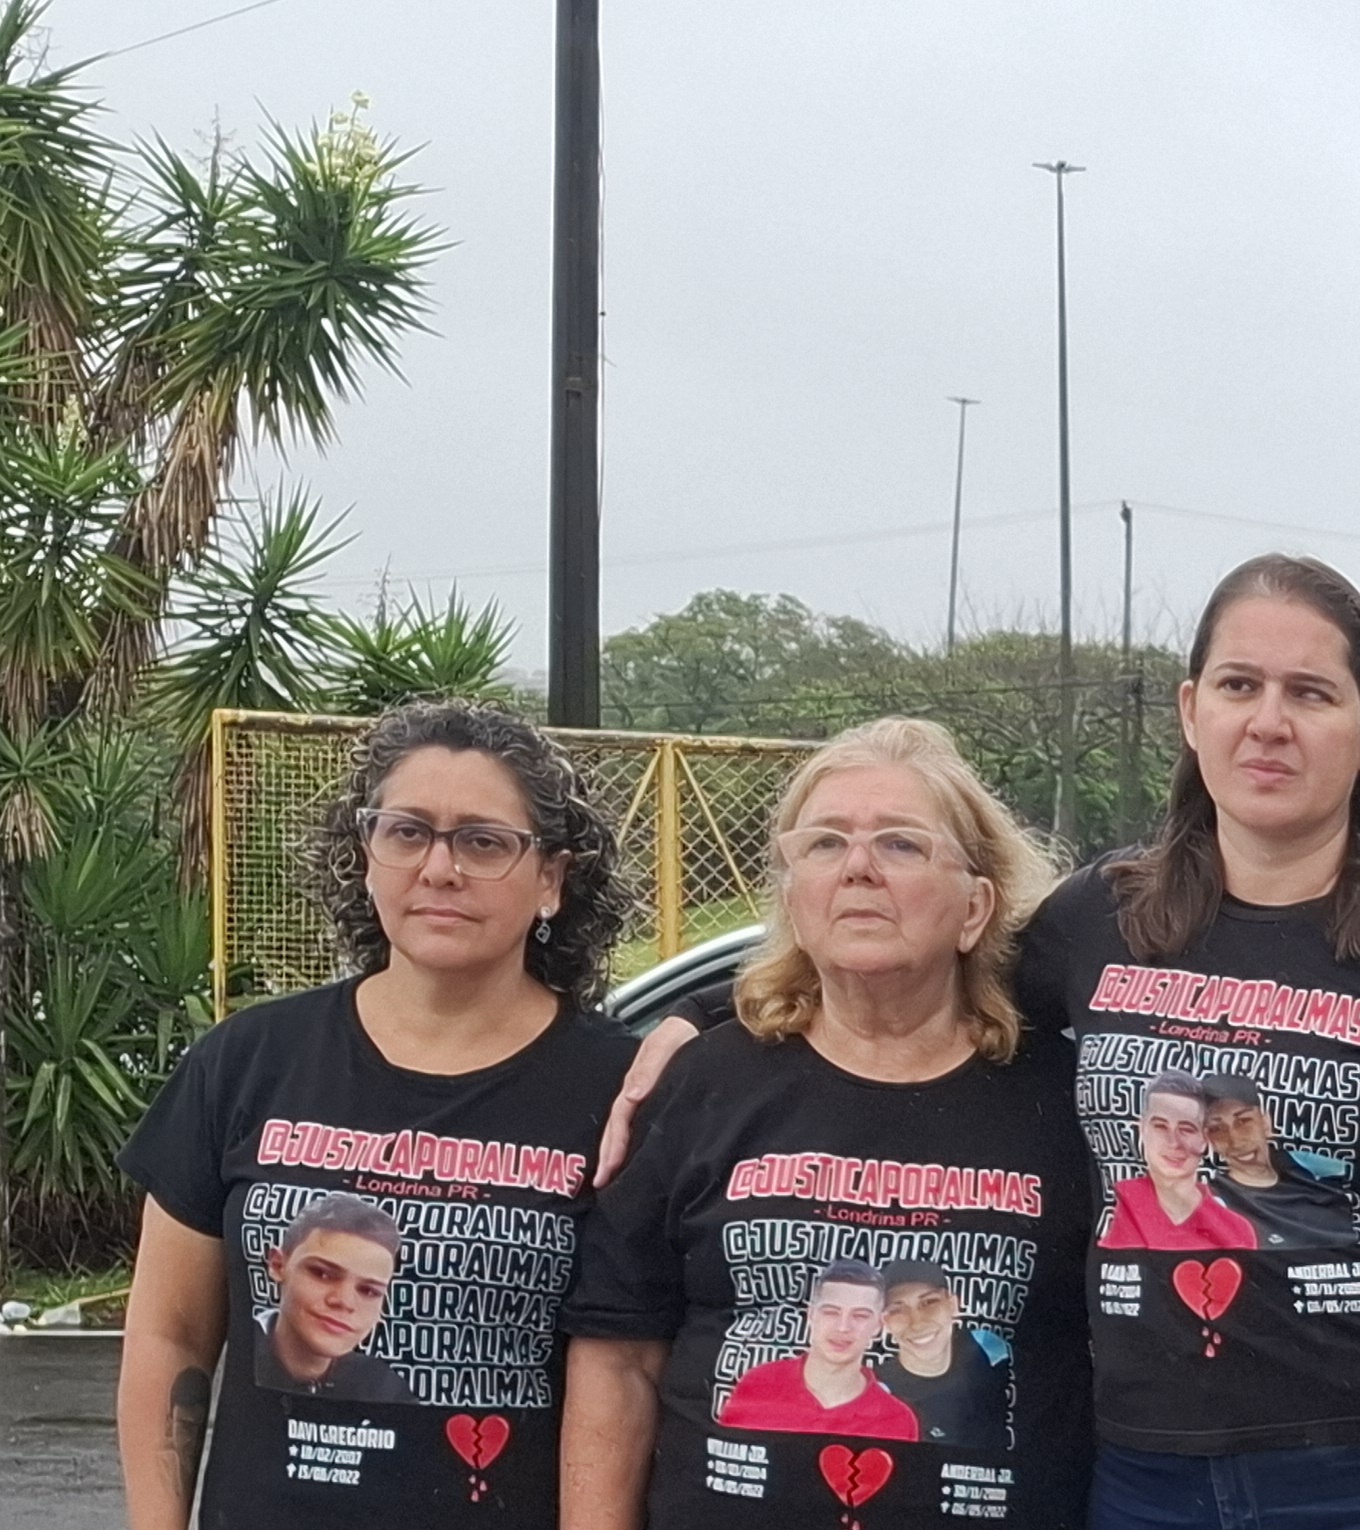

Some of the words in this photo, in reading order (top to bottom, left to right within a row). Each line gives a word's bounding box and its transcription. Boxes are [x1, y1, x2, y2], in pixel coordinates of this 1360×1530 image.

[1158, 1021, 1230, 1043] Londrina
[1232, 1030, 1261, 1045] PR
[355, 1174, 443, 1198] Londrina
[447, 1184, 479, 1200] PR
[826, 1204, 906, 1226] Londrina
[910, 1211, 940, 1227] PR
[288, 1418, 318, 1442] DAVI
[320, 1419, 396, 1450] GREGÓRIO
